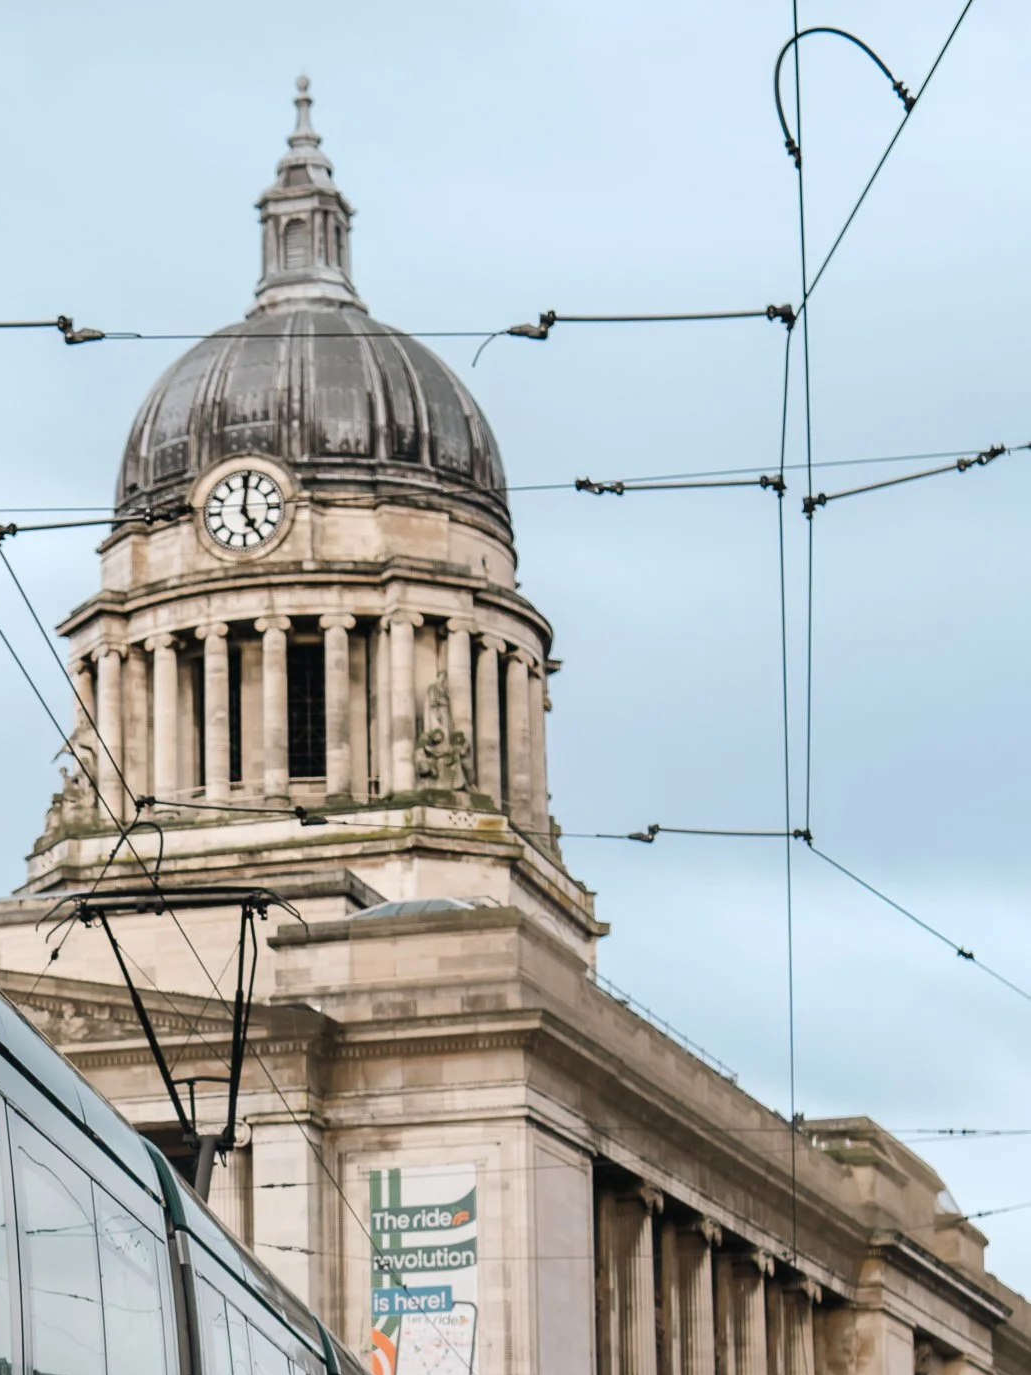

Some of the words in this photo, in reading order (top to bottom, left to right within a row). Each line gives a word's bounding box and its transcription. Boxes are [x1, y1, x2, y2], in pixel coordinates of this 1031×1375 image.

[372, 1211, 410, 1231] The
[412, 1207, 452, 1229] ride
[373, 1248, 475, 1271] revolution
[373, 1293, 390, 1312] is
[394, 1291, 446, 1311] here!
